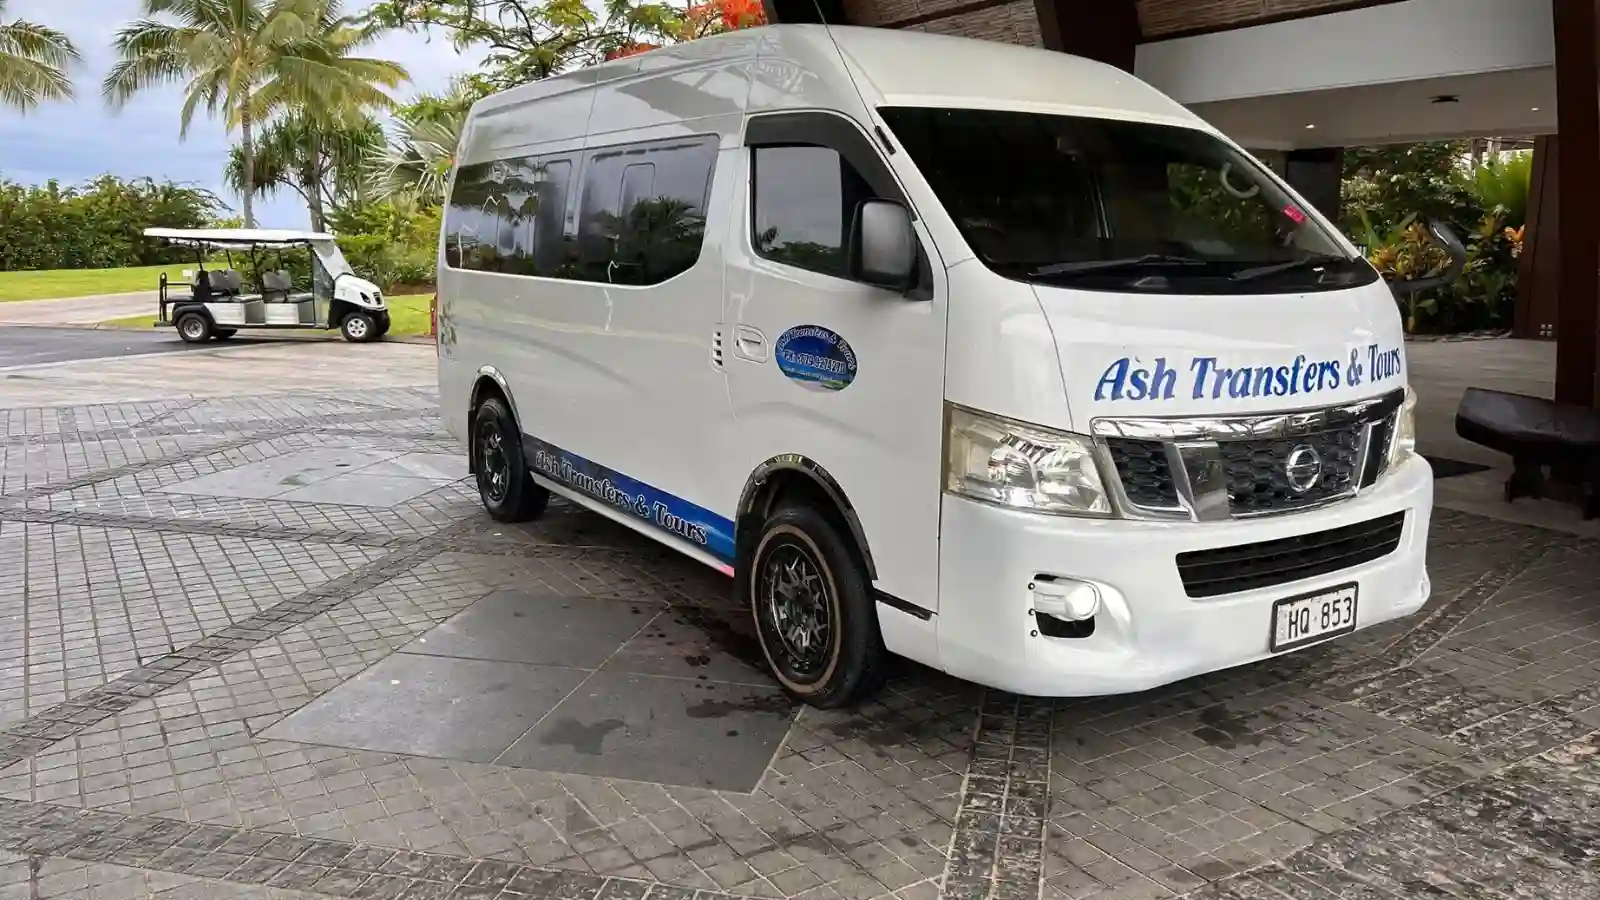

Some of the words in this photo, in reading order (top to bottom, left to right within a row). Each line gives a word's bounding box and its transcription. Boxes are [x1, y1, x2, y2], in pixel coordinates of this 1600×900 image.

[1093, 356, 1177, 401] Ash
[1190, 354, 1340, 400] Transfers
[1346, 348, 1363, 386] &
[1368, 343, 1402, 384] Tours
[535, 450, 562, 478] Ash
[560, 456, 632, 510] Transfers
[633, 494, 651, 519] &
[653, 500, 708, 545] Tours
[1288, 606, 1310, 640] HQ
[1321, 596, 1353, 630] 853
